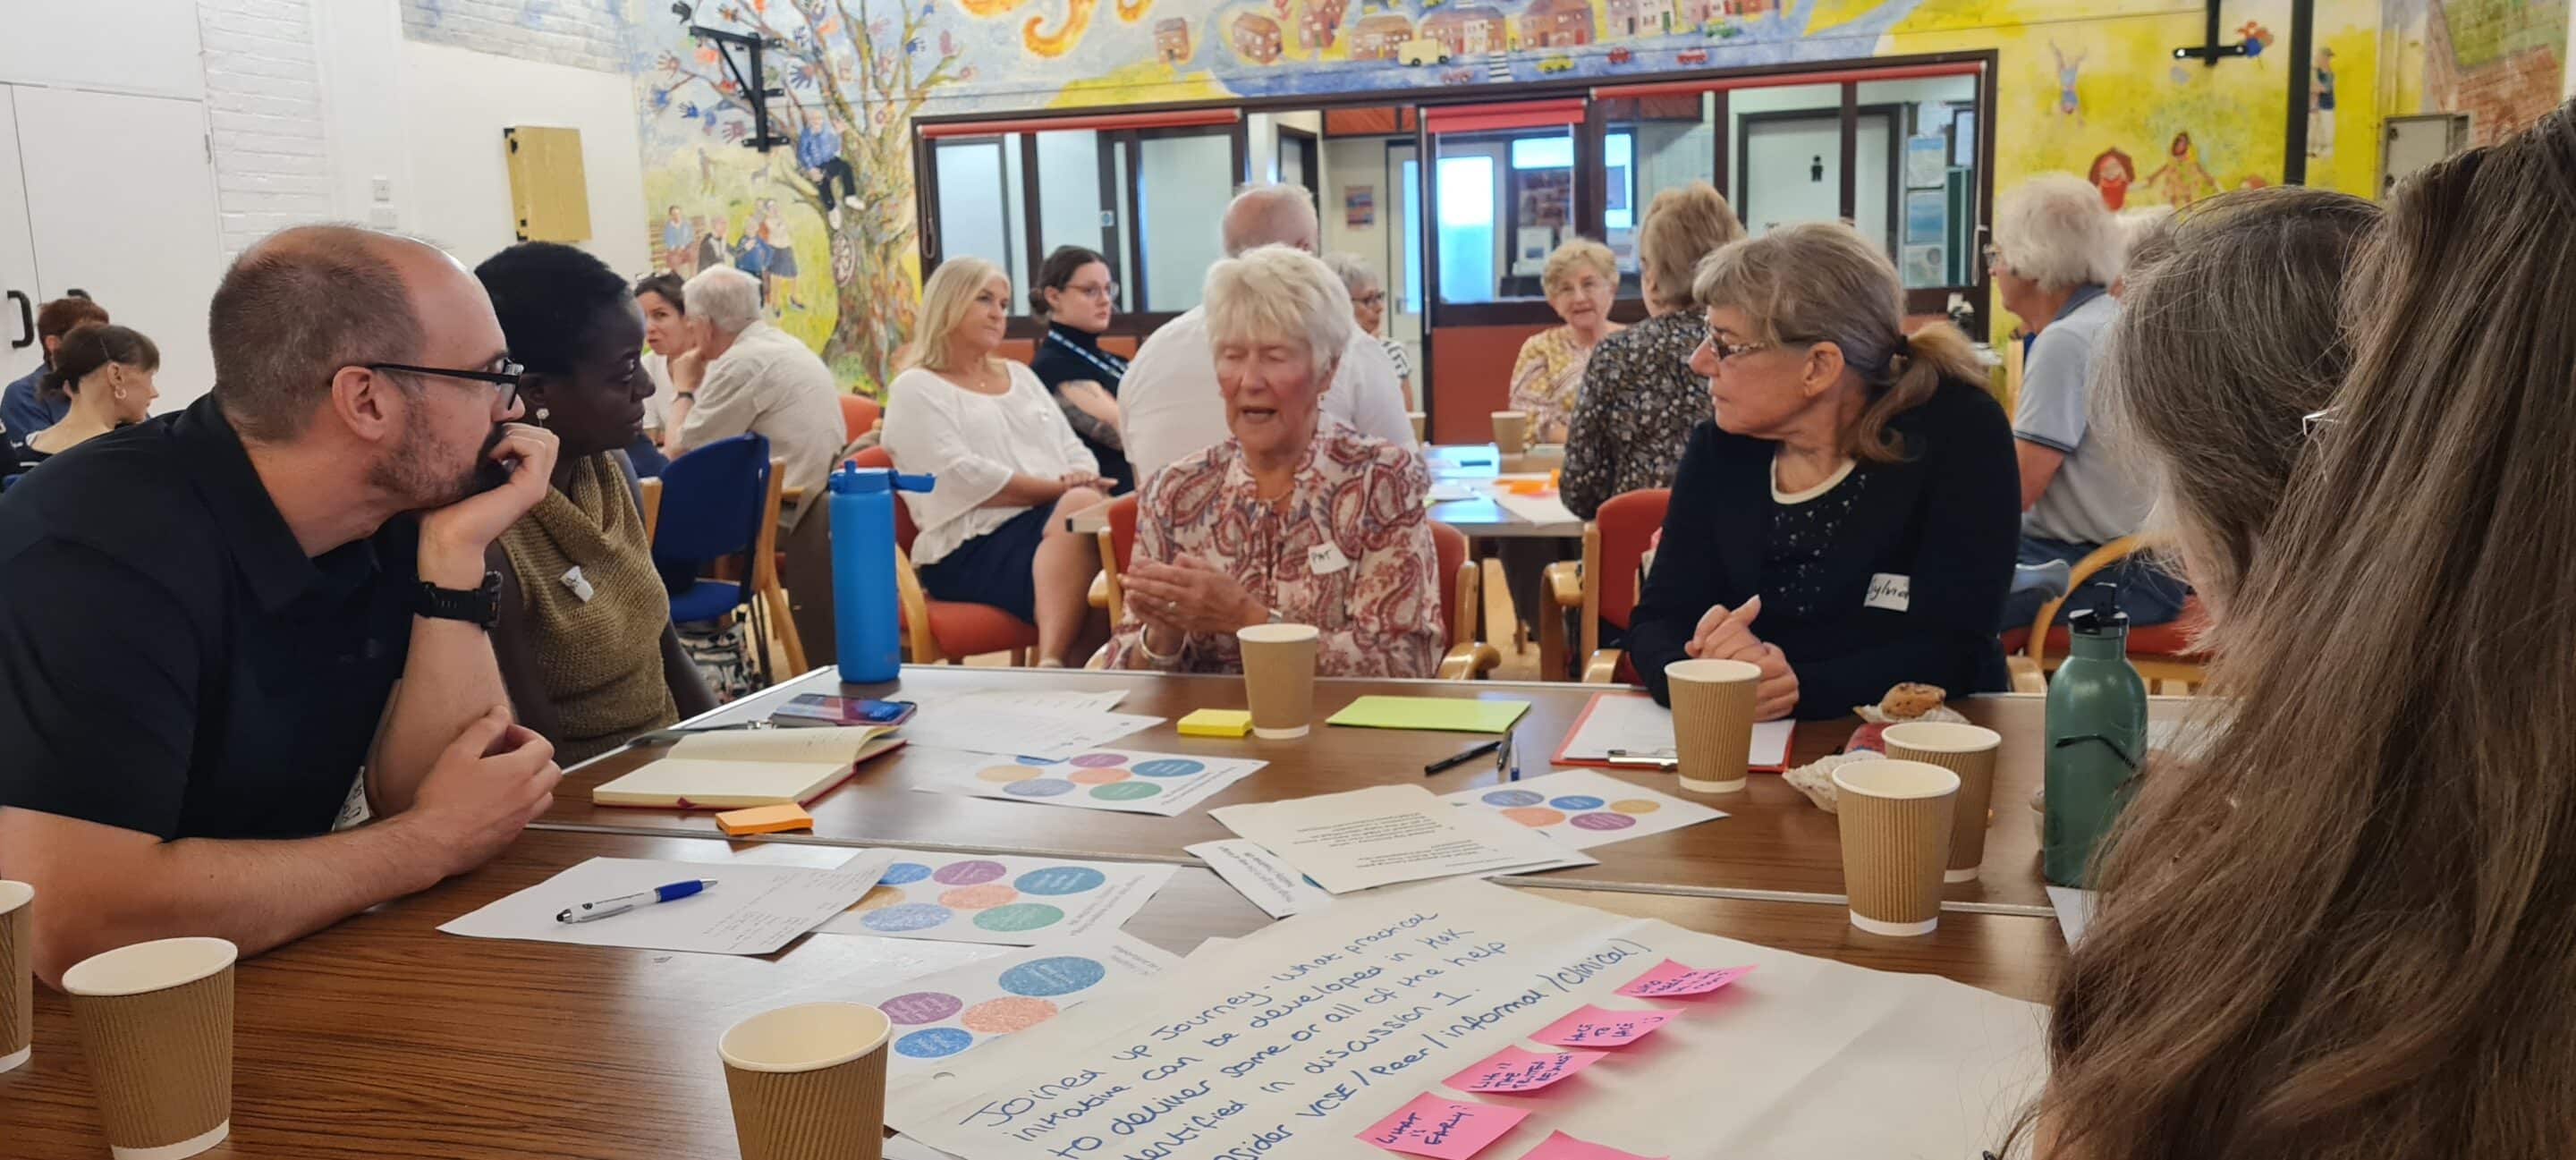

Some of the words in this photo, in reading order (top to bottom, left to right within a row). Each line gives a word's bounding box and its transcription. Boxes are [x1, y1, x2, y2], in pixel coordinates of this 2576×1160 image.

[959, 1069, 1107, 1127] Joined
[1112, 1045, 1152, 1061] up
[1344, 911, 1439, 954] practical
[1002, 1084, 1131, 1142] initiative
[1141, 1055, 1204, 1081] can
[1202, 1031, 1241, 1047] be
[1250, 965, 1385, 1029] developed
[1385, 951, 1414, 962] in
[1110, 1080, 1211, 1136] deliver
[1220, 1044, 1293, 1079] some
[1291, 1024, 1322, 1042] or
[1325, 1003, 1363, 1023] all
[1364, 986, 1399, 1004] of
[1396, 967, 1445, 988] the
[1443, 941, 1507, 967] help
[1259, 1080, 1296, 1093] in
[1304, 1004, 1434, 1074] discussion
